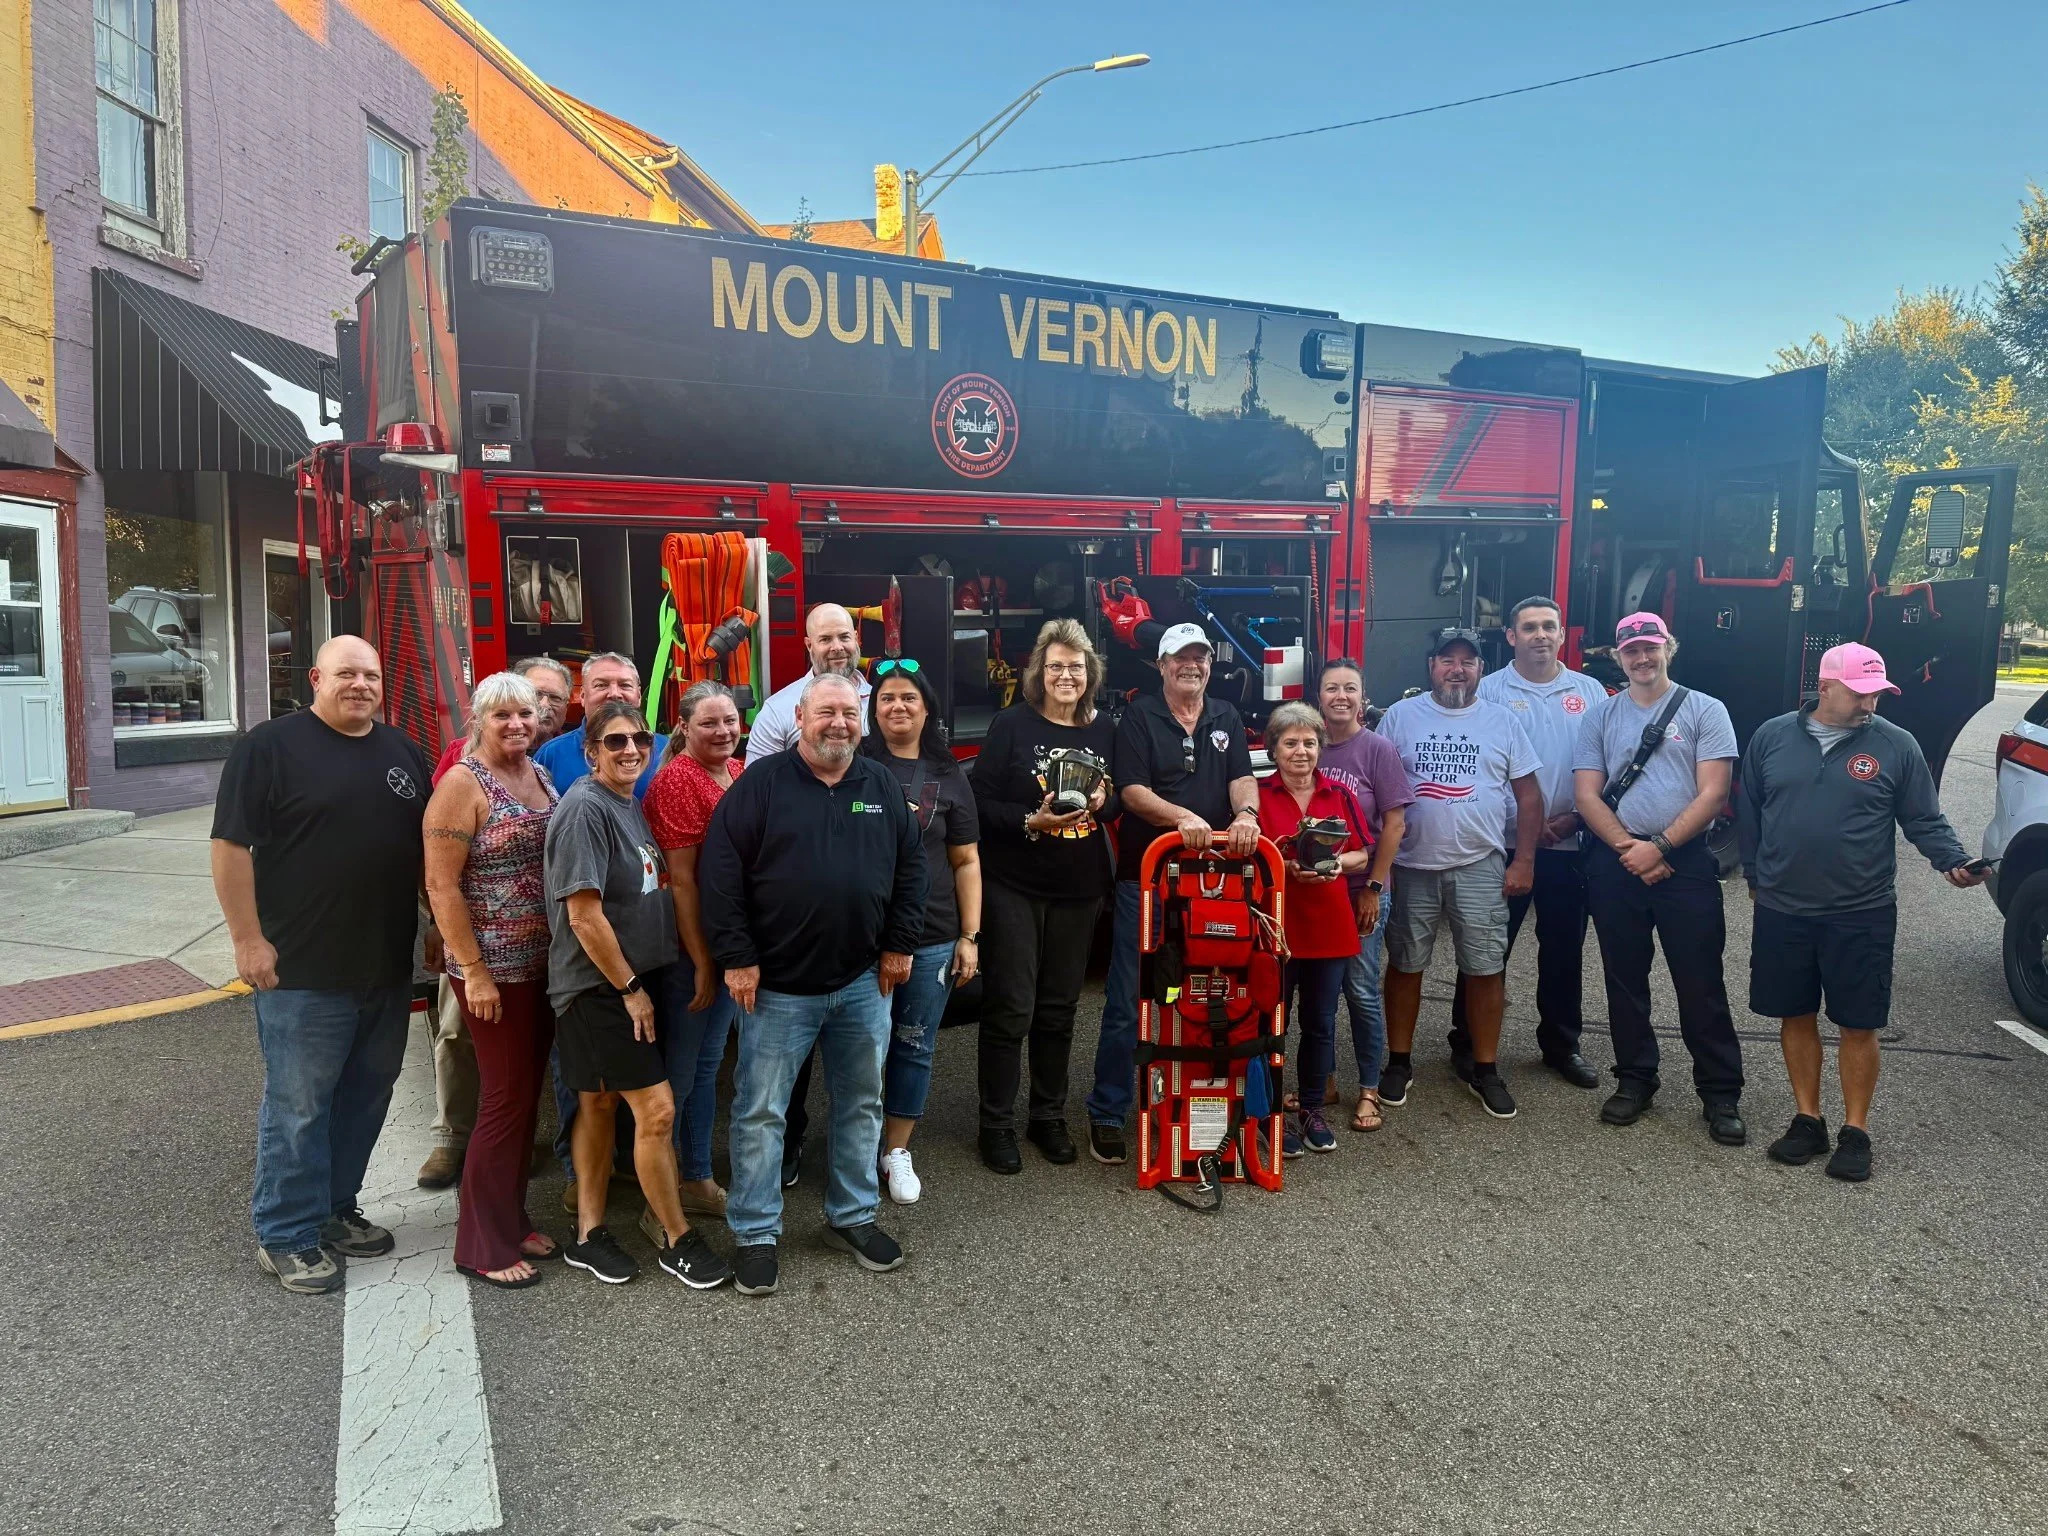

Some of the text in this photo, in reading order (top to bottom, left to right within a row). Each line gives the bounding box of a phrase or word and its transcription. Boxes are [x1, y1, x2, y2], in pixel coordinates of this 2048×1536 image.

[711, 256, 1217, 377] MOUNT VERNON
[940, 380, 1012, 418] CITY OF MOUNT VERNON
[945, 446, 1006, 472] FIRE DEPARTMENT
[1415, 742, 1480, 754] FREEDOM
[1417, 752, 1477, 764] IS WORTH
[1414, 762, 1477, 775] FIGHTING
[1431, 773, 1457, 783] FOR
[1329, 767, 1359, 797] GRADE
